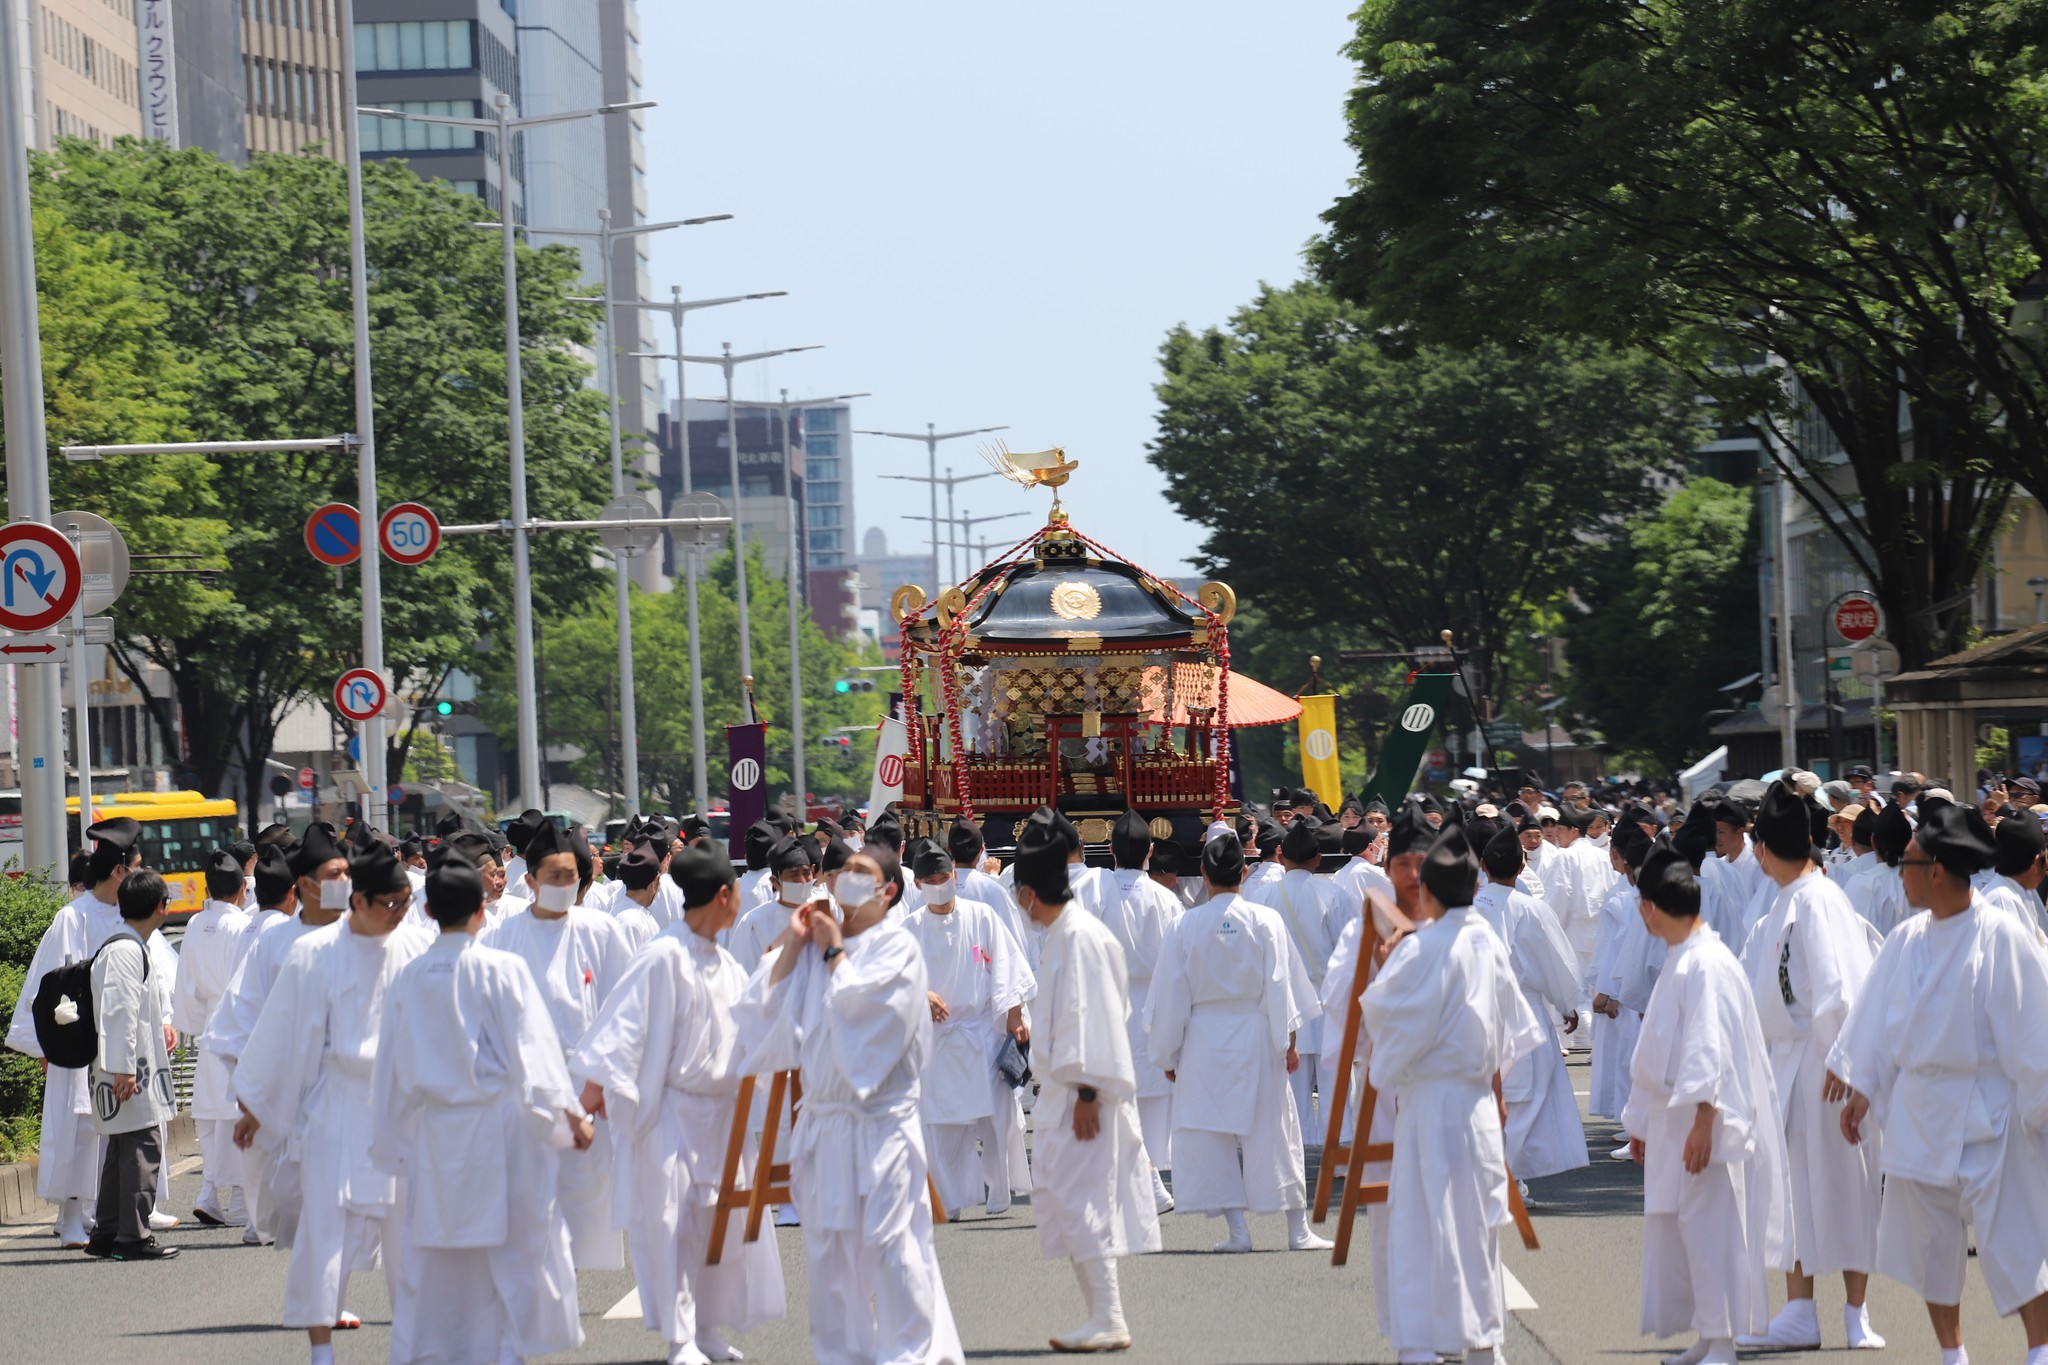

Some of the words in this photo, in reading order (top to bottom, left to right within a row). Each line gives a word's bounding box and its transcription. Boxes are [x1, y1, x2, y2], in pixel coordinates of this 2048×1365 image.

[391, 520, 426, 548] 50
[1838, 610, 1876, 628] 消火栓
